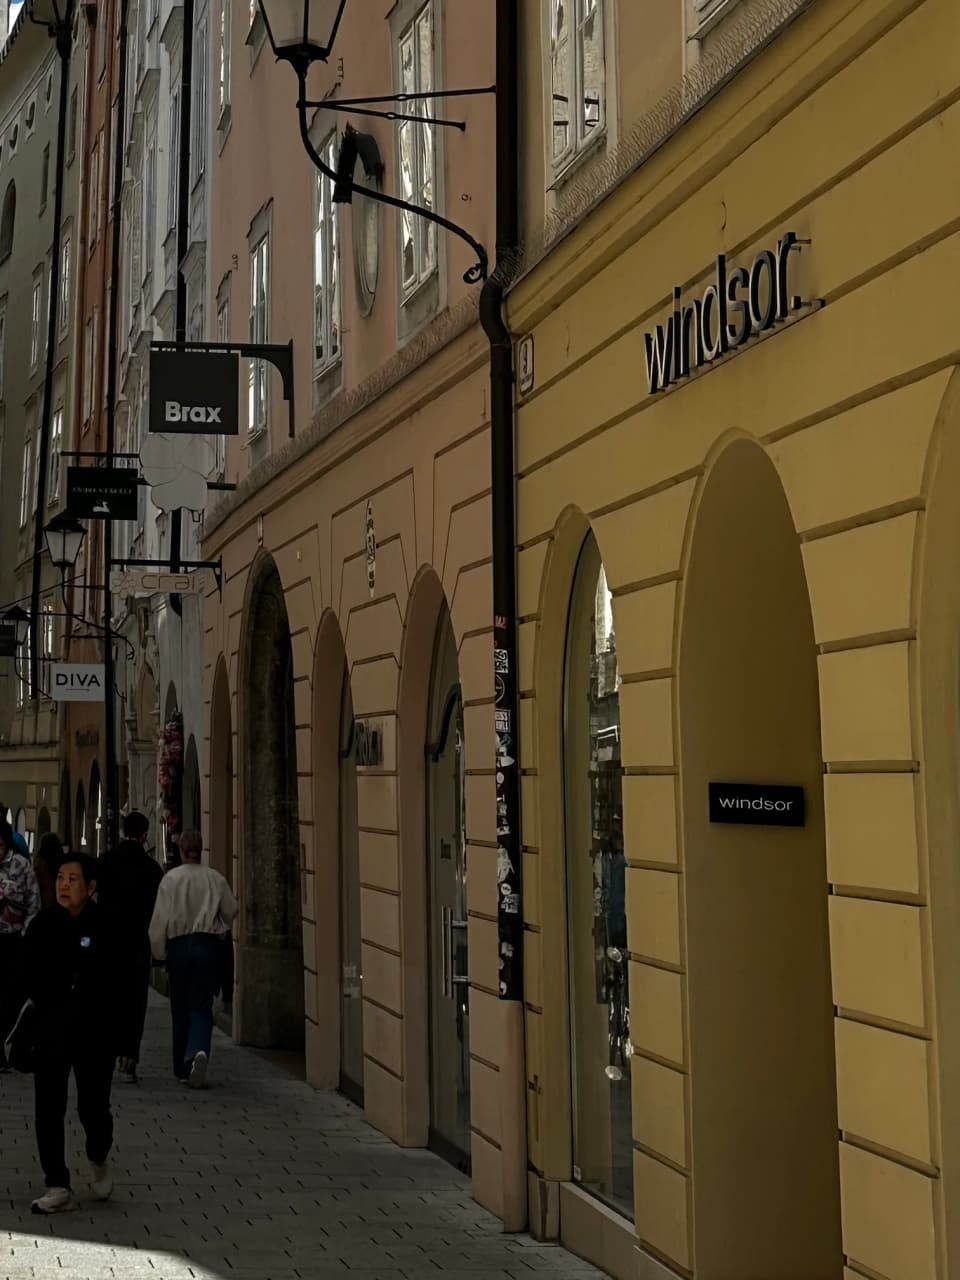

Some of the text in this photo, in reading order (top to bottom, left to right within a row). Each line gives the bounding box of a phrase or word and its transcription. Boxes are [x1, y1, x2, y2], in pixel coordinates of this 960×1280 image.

[644, 231, 803, 395] windsor.
[164, 401, 222, 424] Brax
[55, 673, 101, 687] DIVA
[718, 796, 794, 812] windsor
